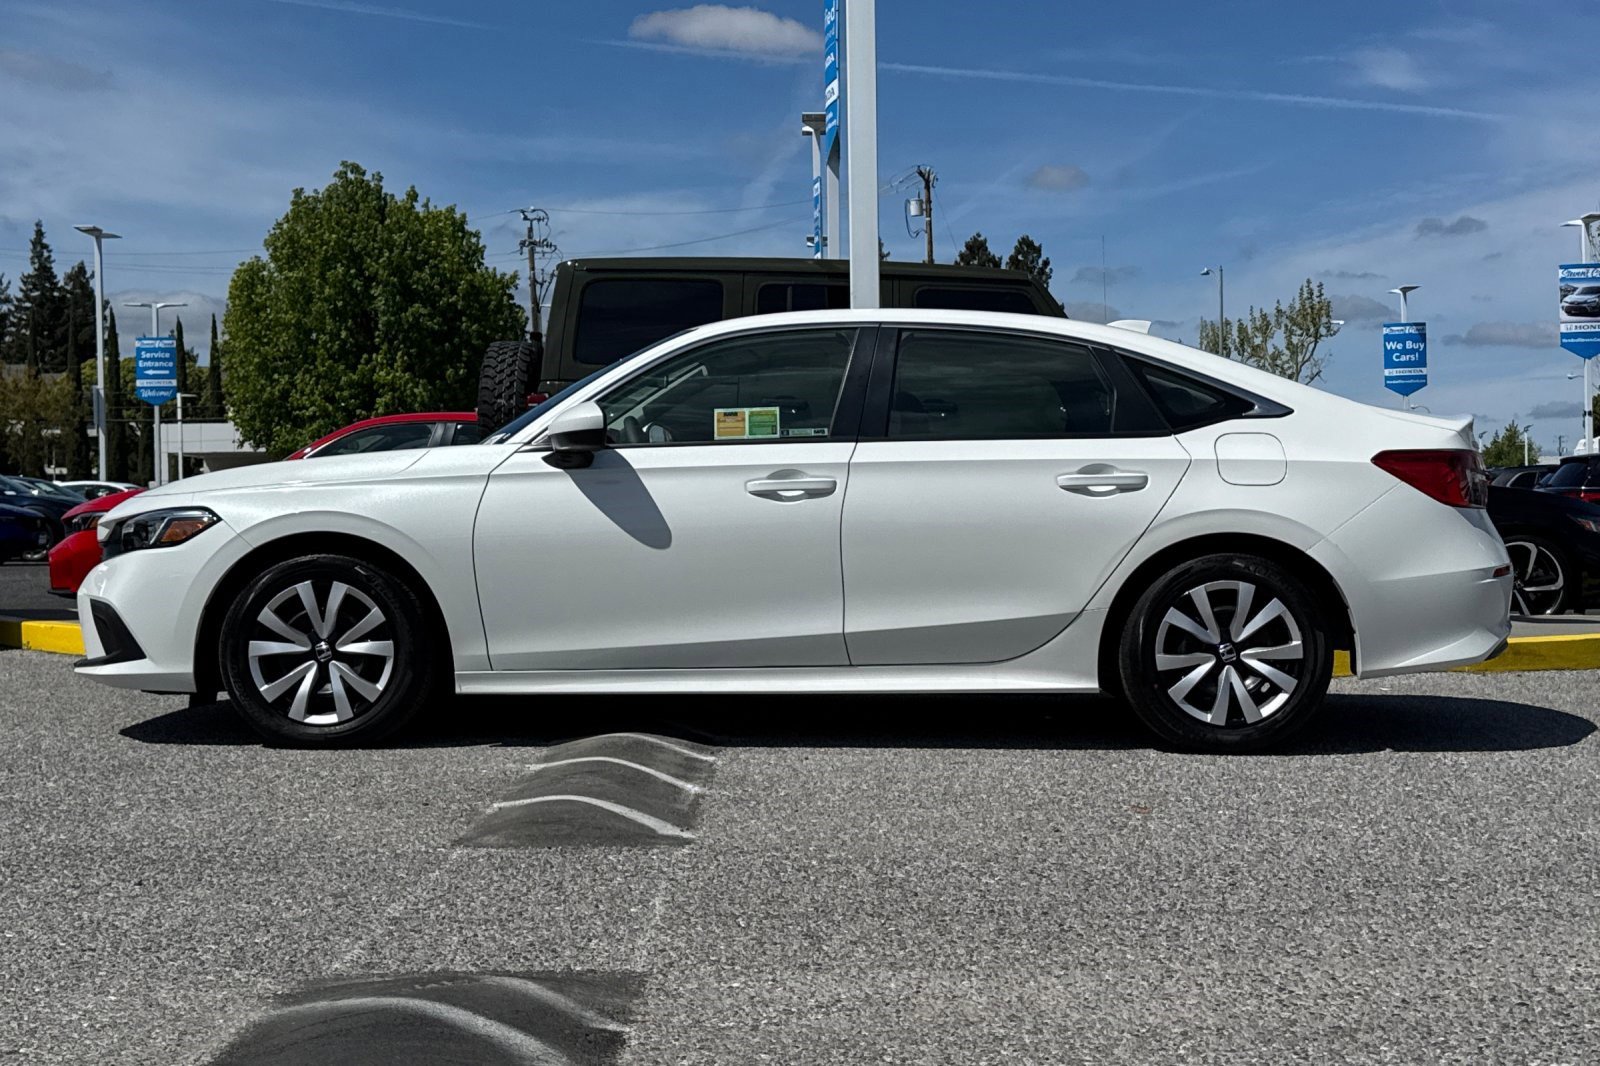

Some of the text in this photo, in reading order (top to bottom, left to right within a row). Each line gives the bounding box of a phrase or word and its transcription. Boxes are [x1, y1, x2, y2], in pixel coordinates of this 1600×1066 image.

[1385, 340, 1424, 351] We Buy
[1392, 352, 1418, 361] Cars!
